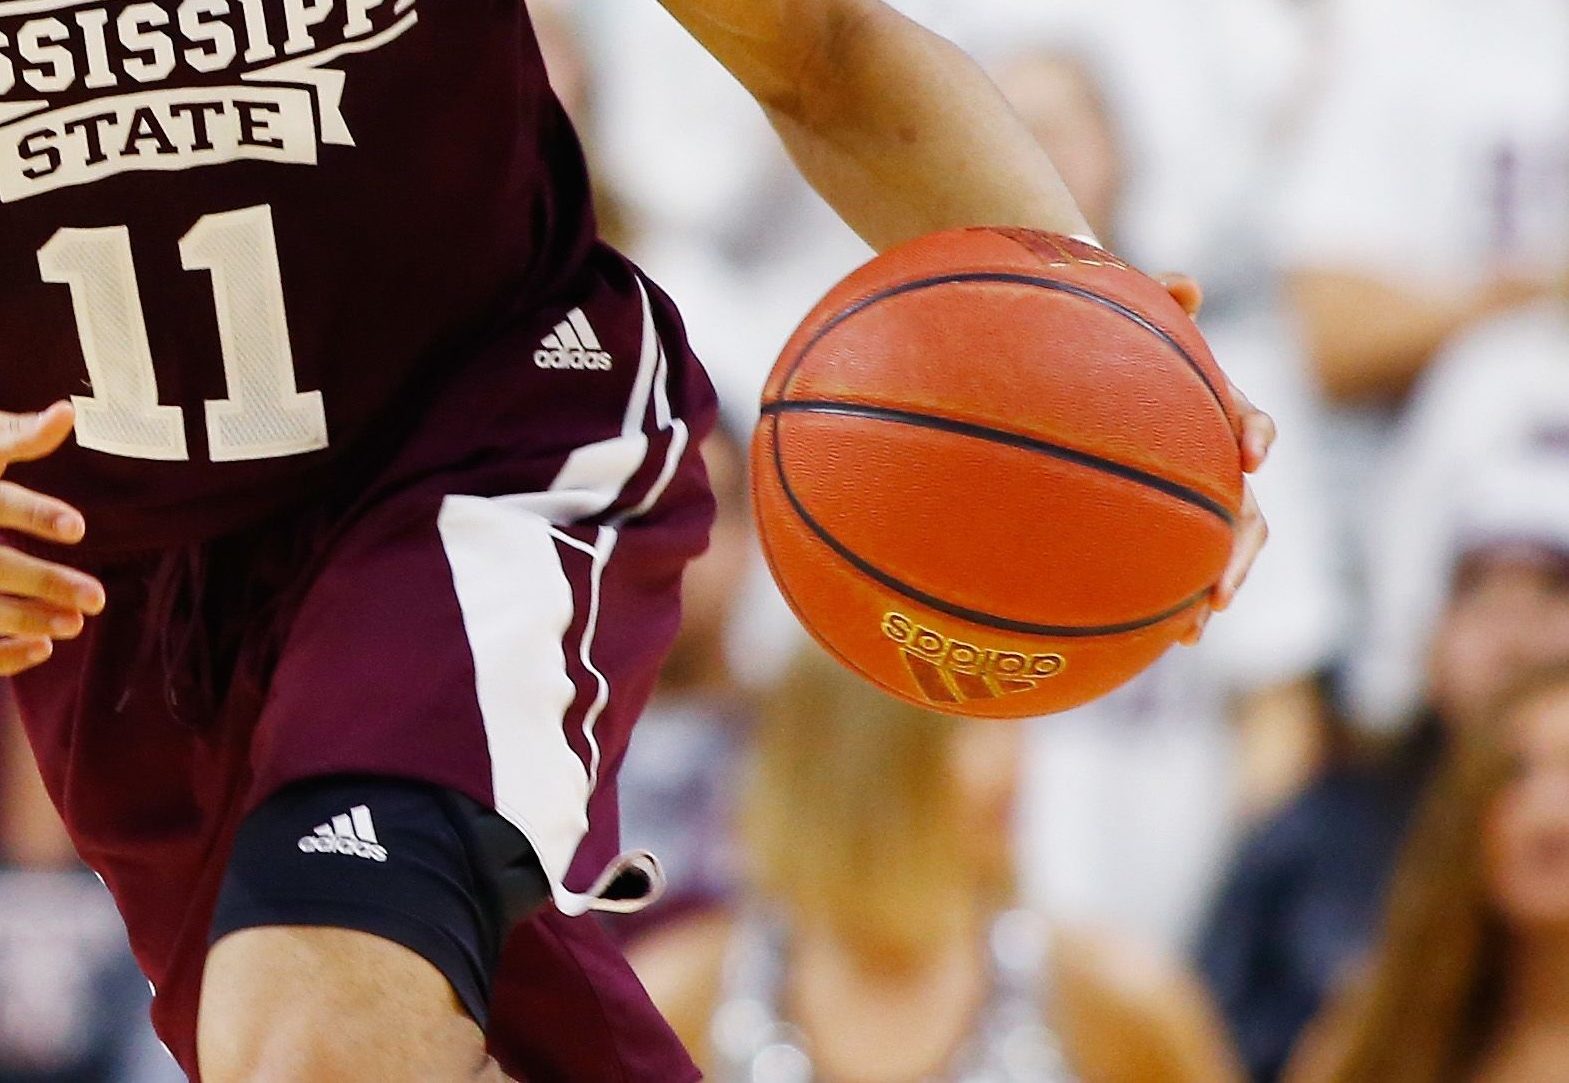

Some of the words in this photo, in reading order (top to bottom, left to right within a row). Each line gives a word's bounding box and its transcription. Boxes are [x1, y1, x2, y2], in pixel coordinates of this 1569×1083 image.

[17, 99, 284, 181] STATE
[36, 203, 329, 463] 11
[533, 348, 613, 372] adidas
[881, 611, 1068, 680] adidas
[297, 833, 389, 863] adidas
